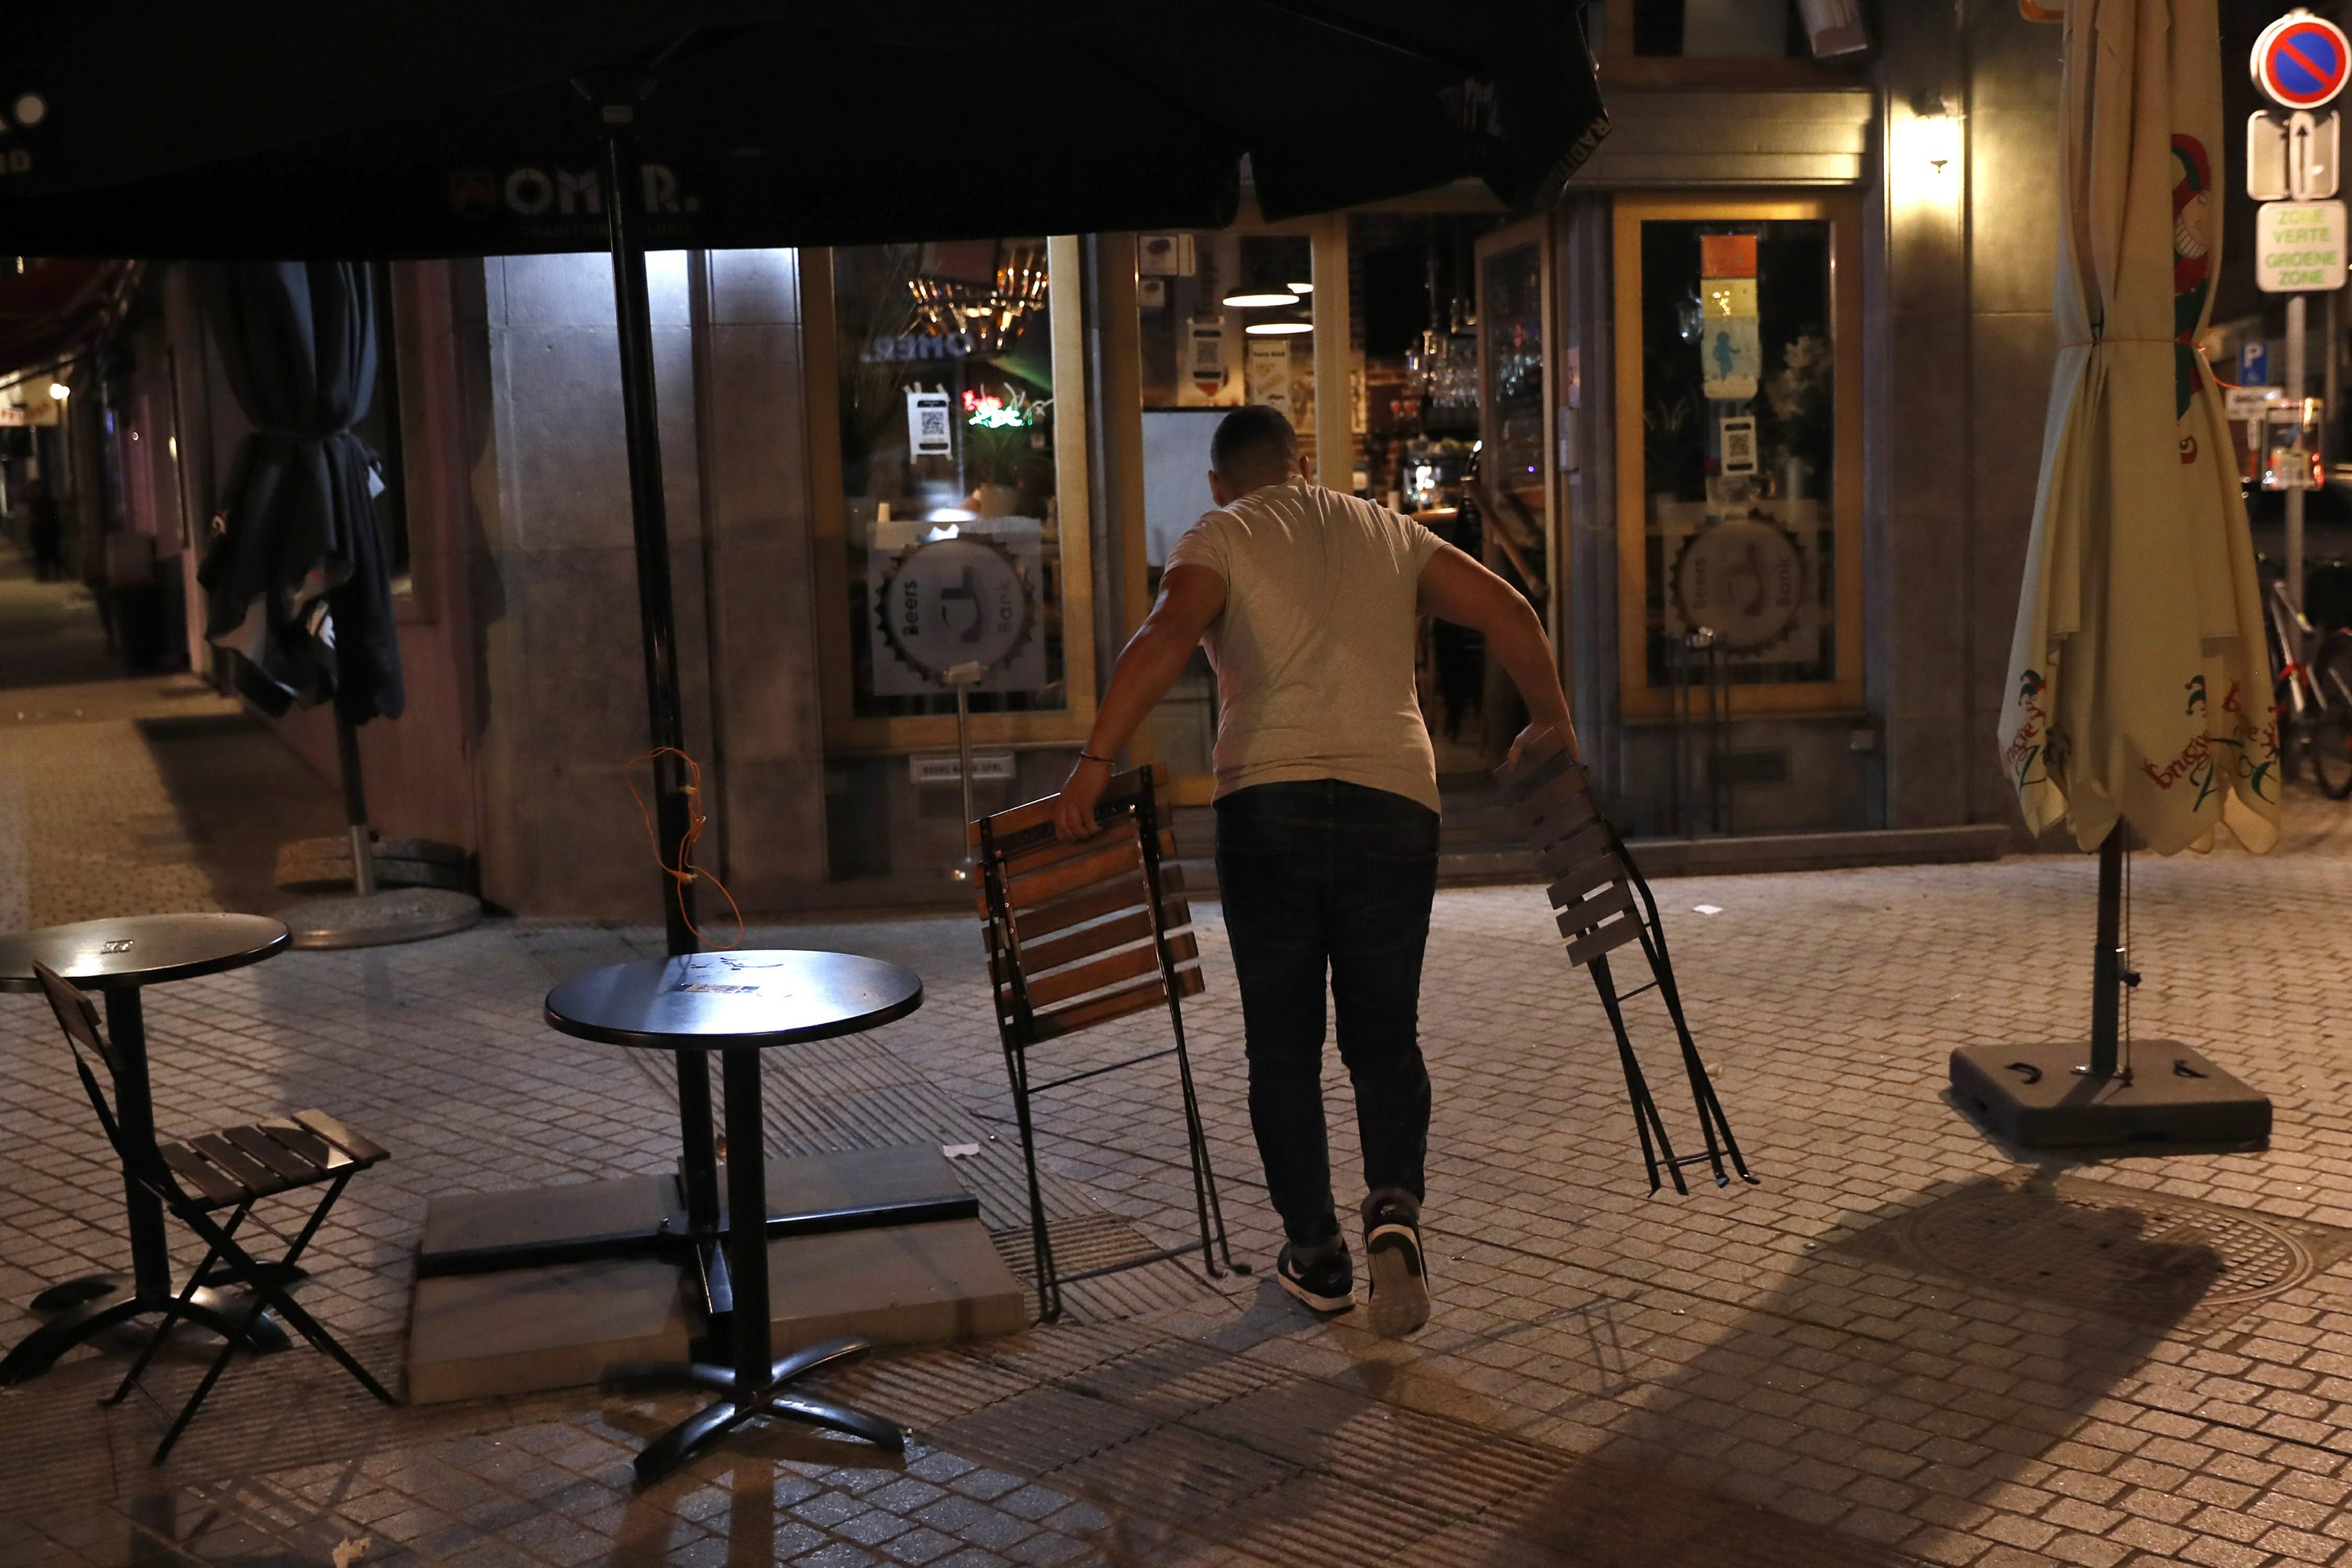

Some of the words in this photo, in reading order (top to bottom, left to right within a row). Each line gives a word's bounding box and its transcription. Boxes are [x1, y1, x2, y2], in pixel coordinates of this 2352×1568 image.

[504, 164, 700, 216] OMR.
[2273, 226, 2331, 244] VERTE
[2278, 208, 2324, 225] ZONE
[2265, 250, 2336, 268] GROENE
[2278, 269, 2324, 286] ZONE
[2243, 341, 2263, 369] P
[1693, 557, 1708, 609] Beers
[1776, 557, 1791, 607] Bank
[902, 580, 920, 636] Beers
[996, 580, 1013, 633] Bank
